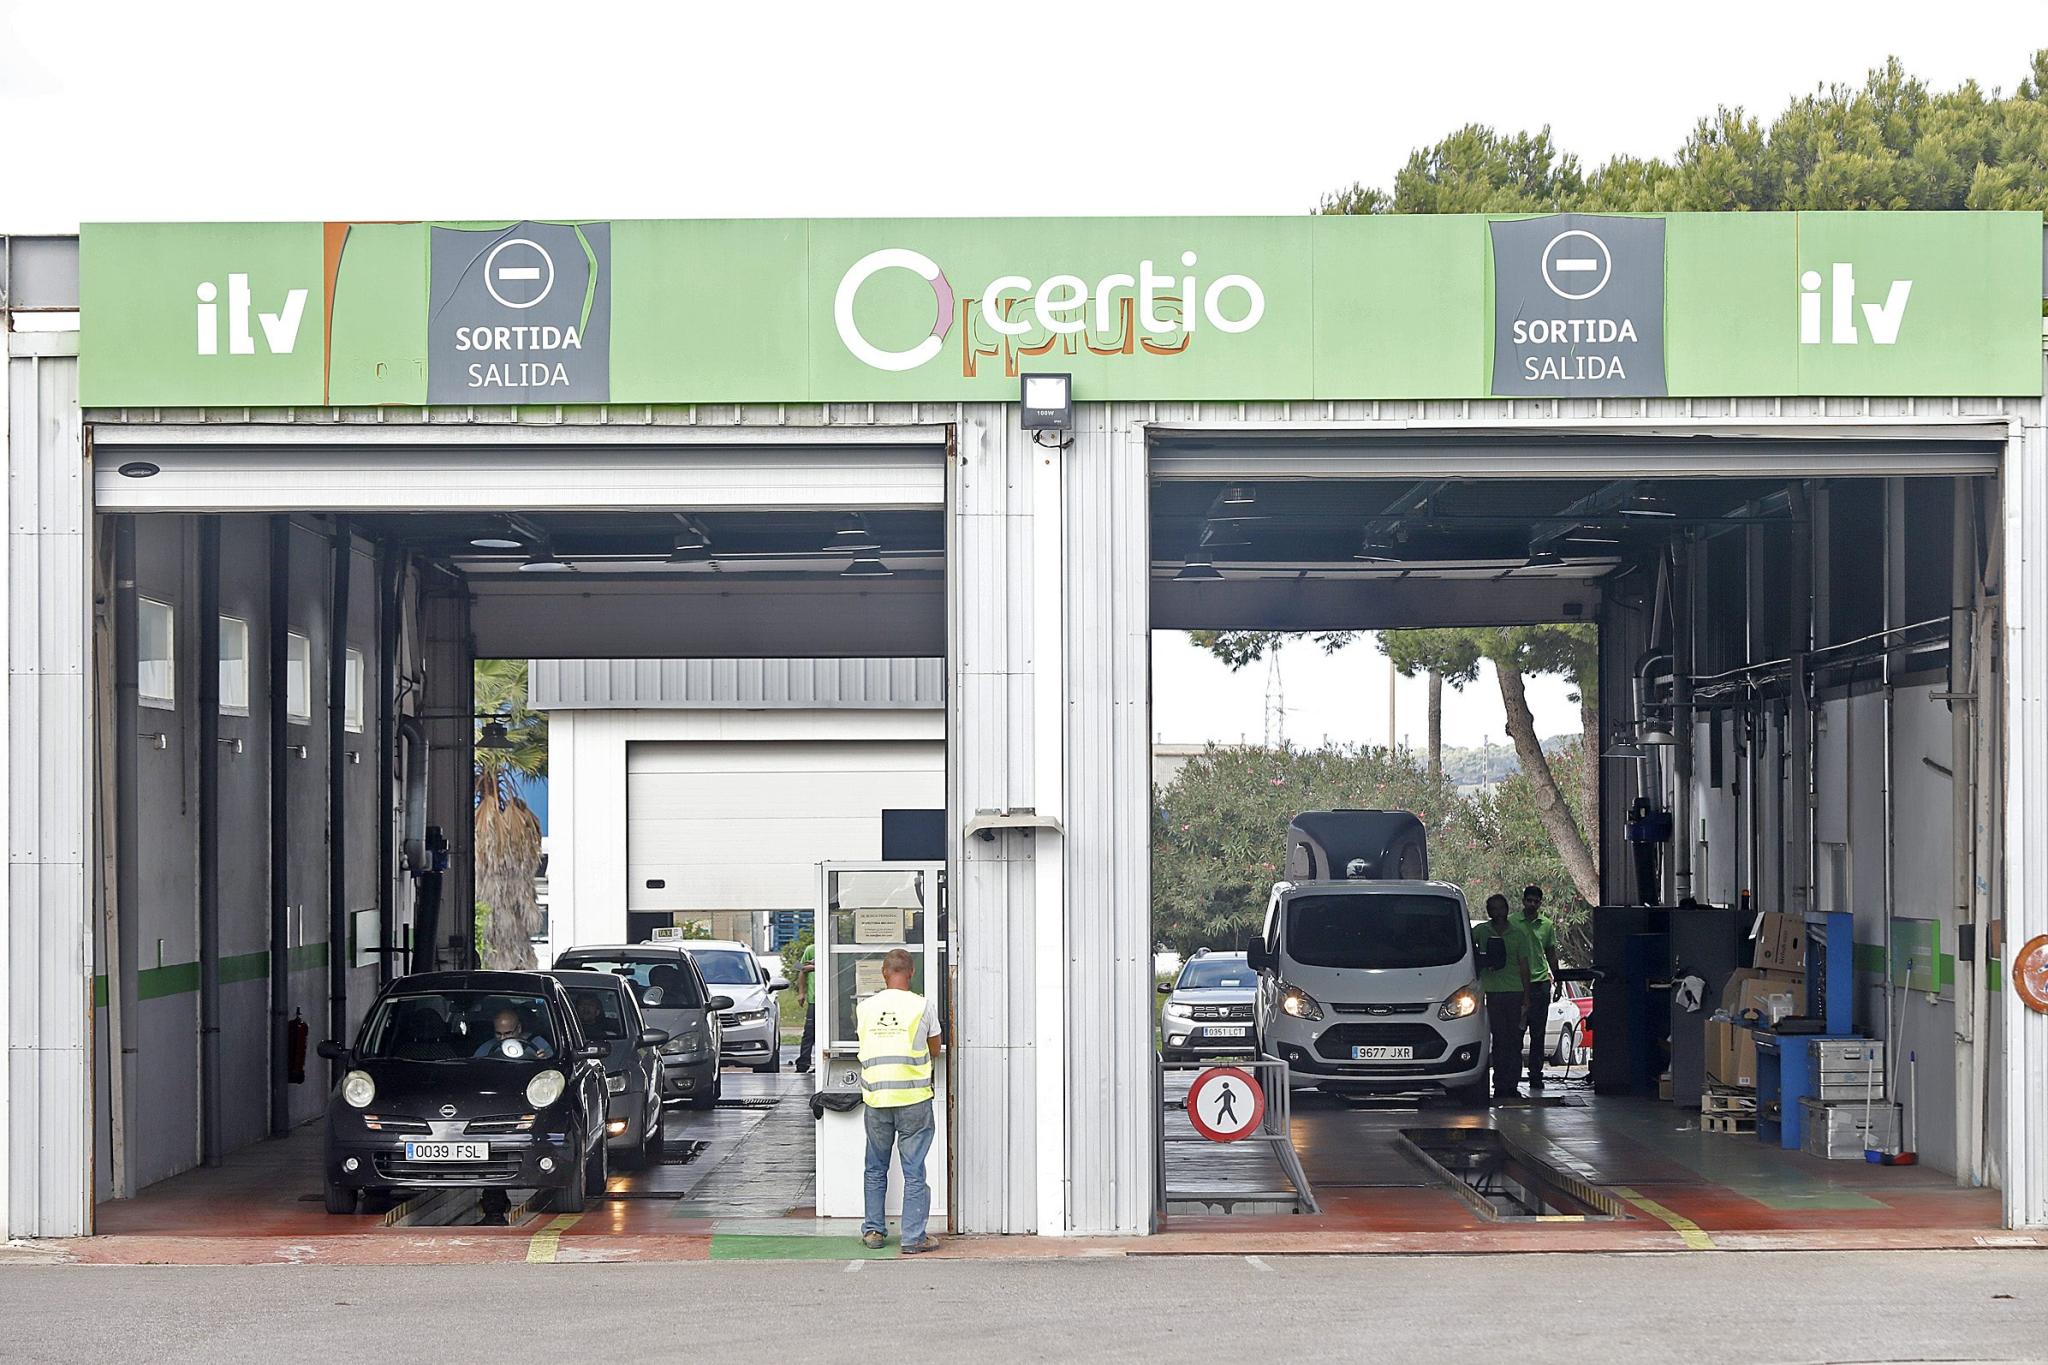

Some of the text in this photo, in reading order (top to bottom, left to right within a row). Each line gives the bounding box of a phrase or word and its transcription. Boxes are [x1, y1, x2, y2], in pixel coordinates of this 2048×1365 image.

[981, 251, 1265, 335] certio
[455, 326, 583, 351] SORTIDA
[1512, 319, 1638, 344] SORTIDA
[467, 362, 570, 388] SALIDA
[1524, 355, 1626, 381] SALIDA
[1209, 1028, 1226, 1036] 0351
[1360, 1047, 1410, 1058] 9677 JXR
[416, 1145, 481, 1158] 0039 FSL
